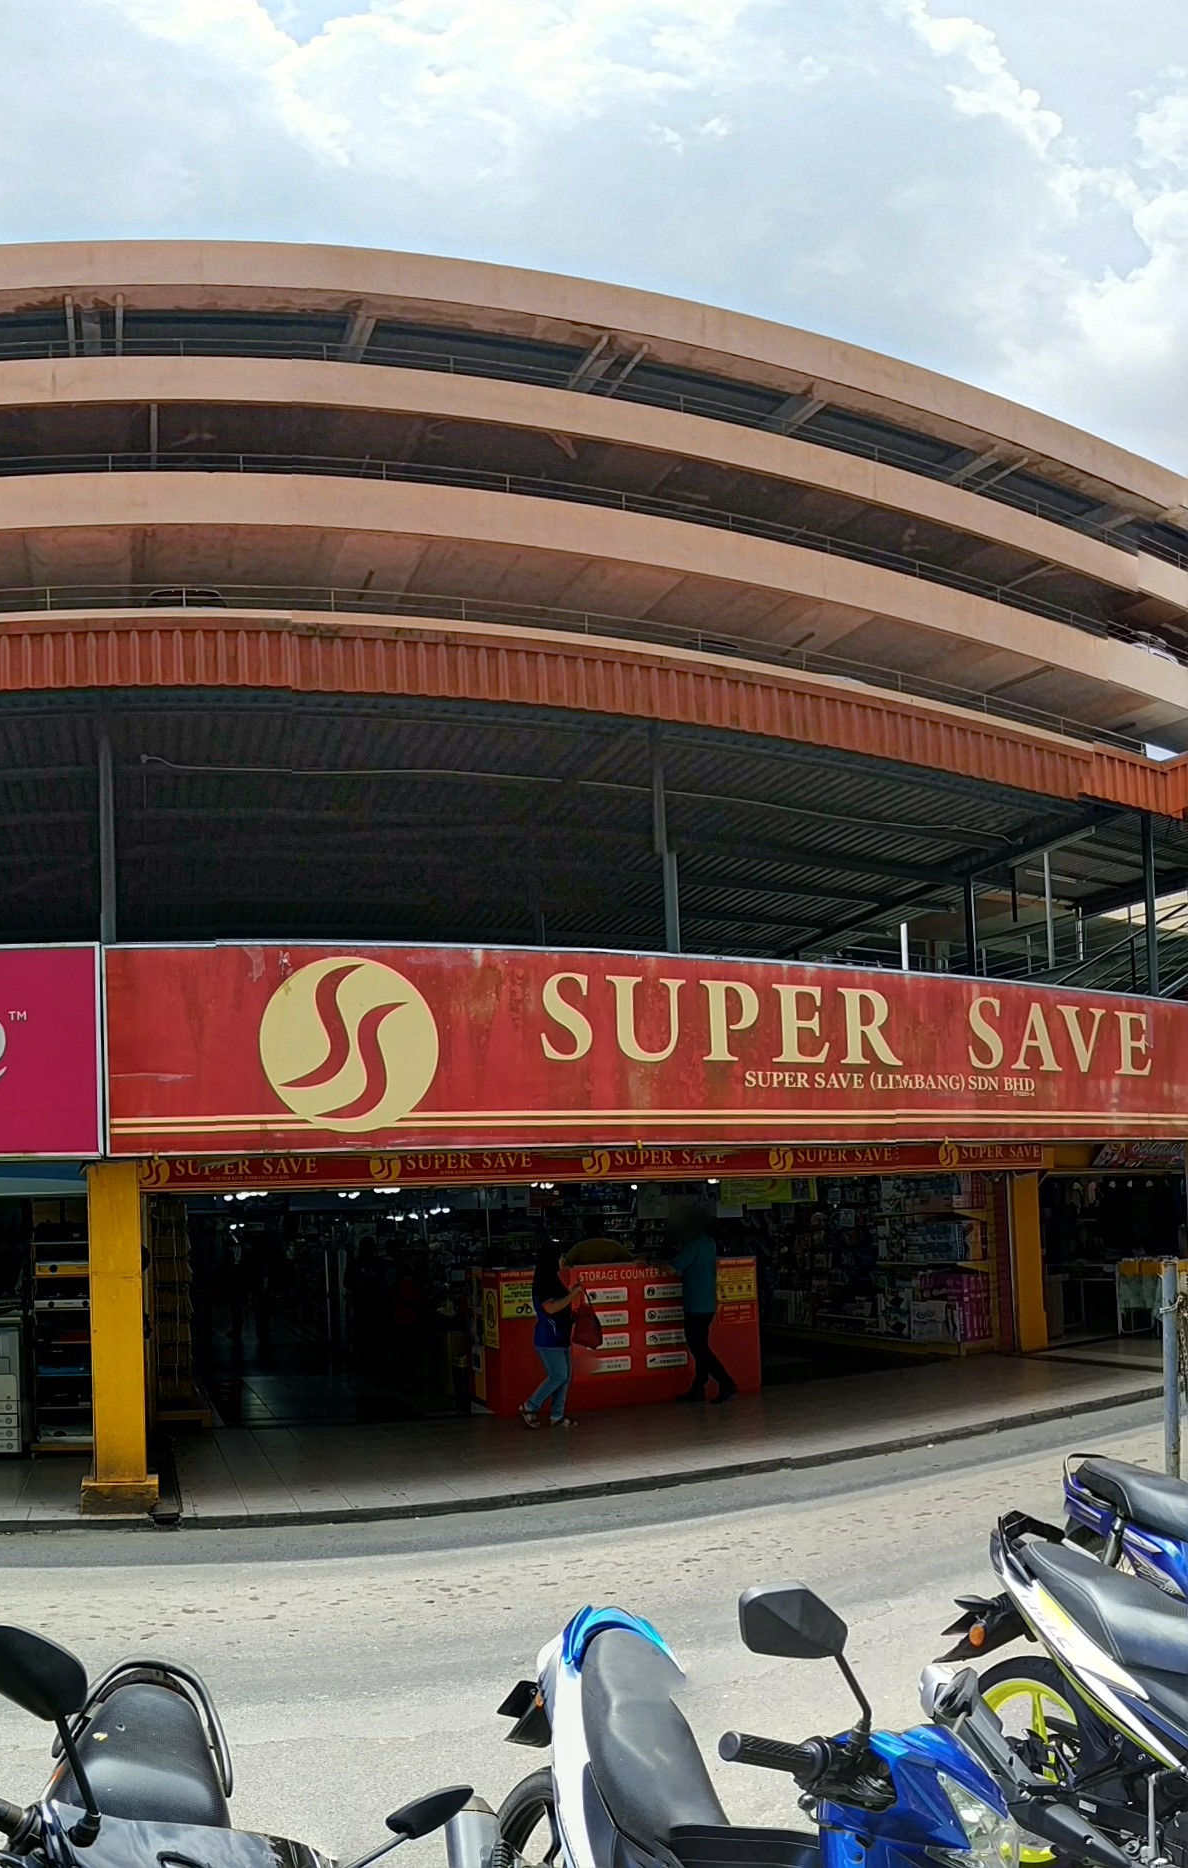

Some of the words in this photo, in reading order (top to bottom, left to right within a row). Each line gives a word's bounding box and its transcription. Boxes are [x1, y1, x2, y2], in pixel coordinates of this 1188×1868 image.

[541, 971, 903, 1067] SUPER
[967, 995, 1154, 1077] SAVE
[744, 1070, 809, 1089] SUPER
[813, 1072, 865, 1090] SAVE
[870, 1071, 965, 1092] (LIMBANG)
[968, 1075, 1000, 1091] SDN
[1003, 1076, 1035, 1092] BHD
[613, 1150, 673, 1166] SUPER
[682, 1149, 726, 1165] SAVE
[796, 1147, 848, 1163] SUPER
[854, 1147, 893, 1162] SAVE
[961, 1144, 1004, 1159] SUPER
[1009, 1144, 1041, 1158] SAVE
[262, 1157, 318, 1175] SAVE
[405, 1153, 474, 1171] SUPER
[481, 1152, 533, 1169] SAVE
[578, 1270, 618, 1282] STORAGE
[620, 1268, 660, 1280] COUNTER
